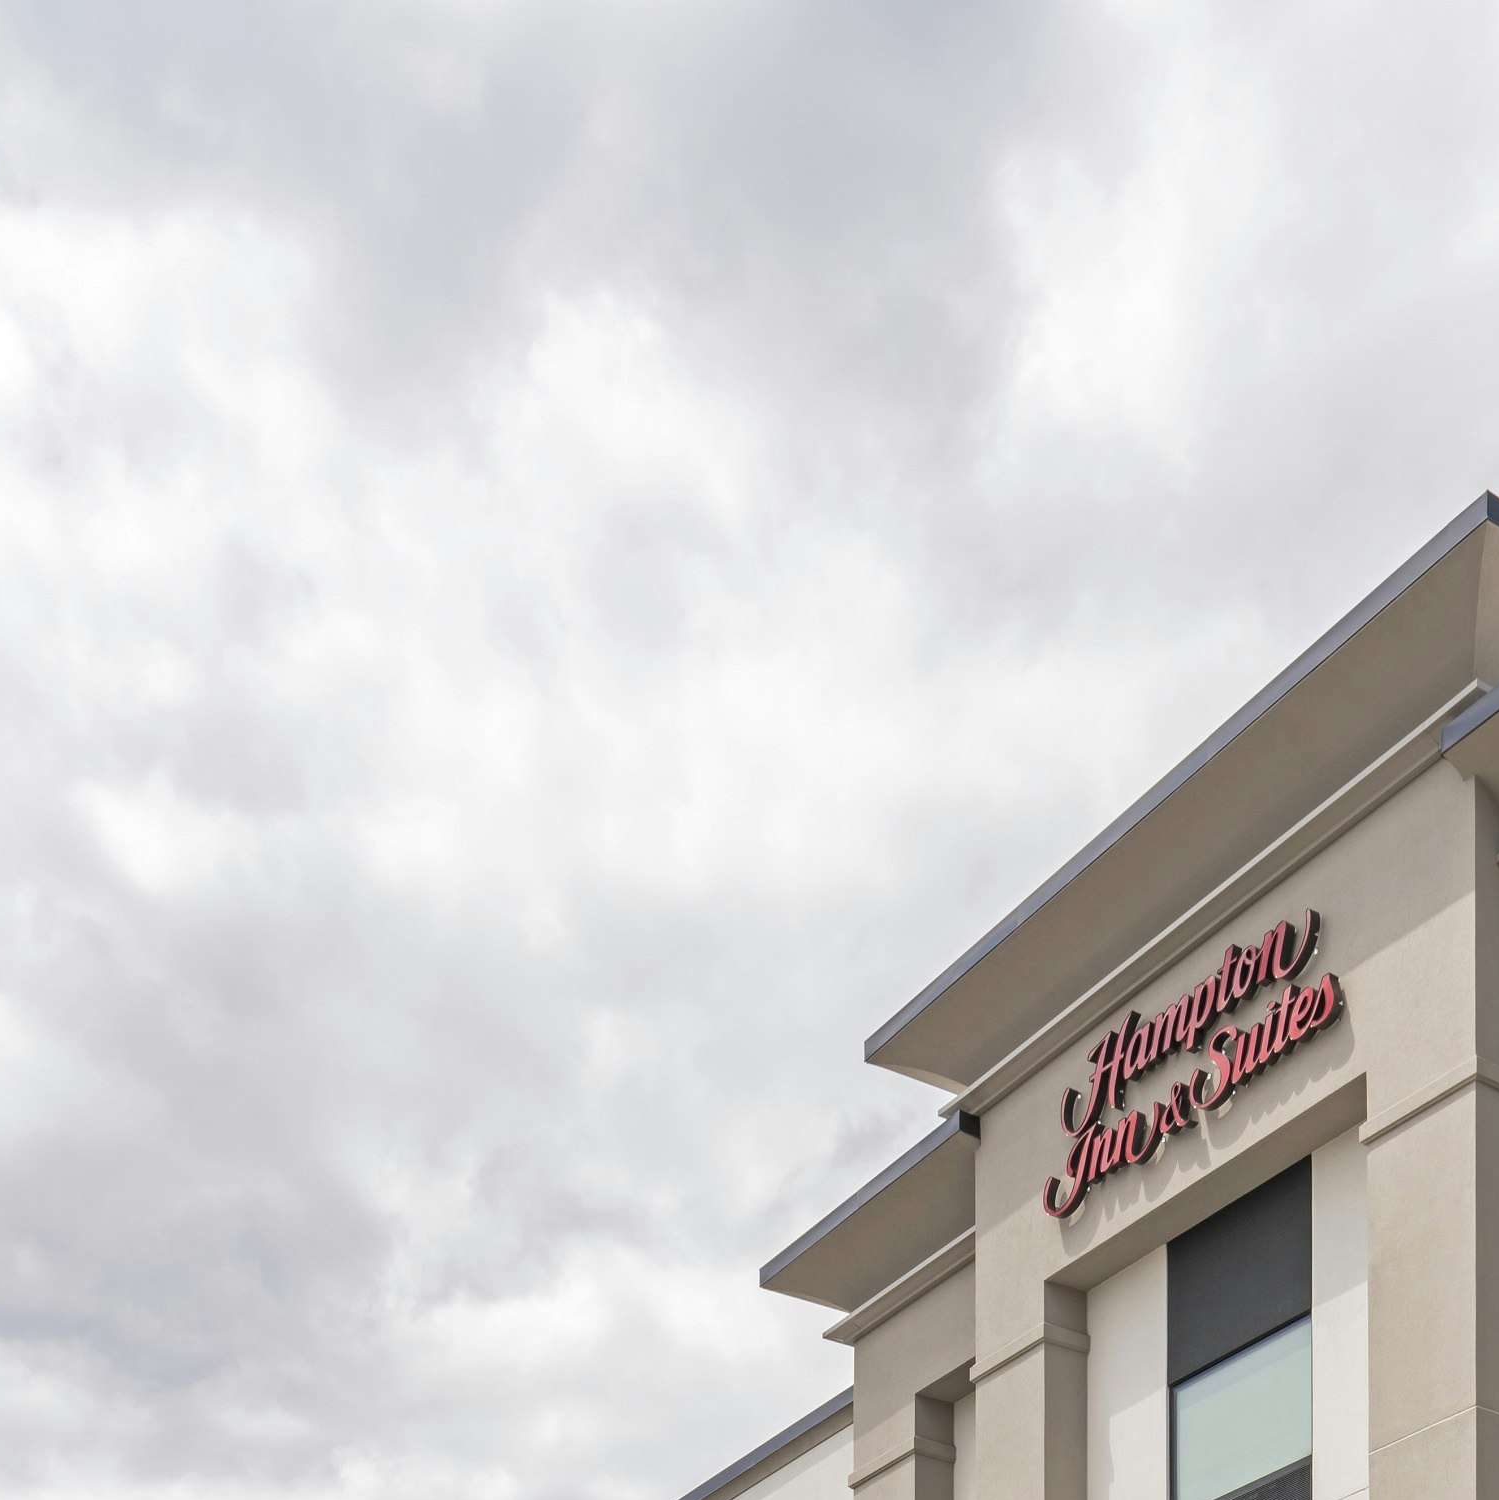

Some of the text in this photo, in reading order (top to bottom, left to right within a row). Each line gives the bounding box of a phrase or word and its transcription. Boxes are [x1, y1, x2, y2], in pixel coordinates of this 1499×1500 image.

[1043, 972, 1344, 1219] Inn & Suites
[1060, 907, 1321, 1137] Hampton
